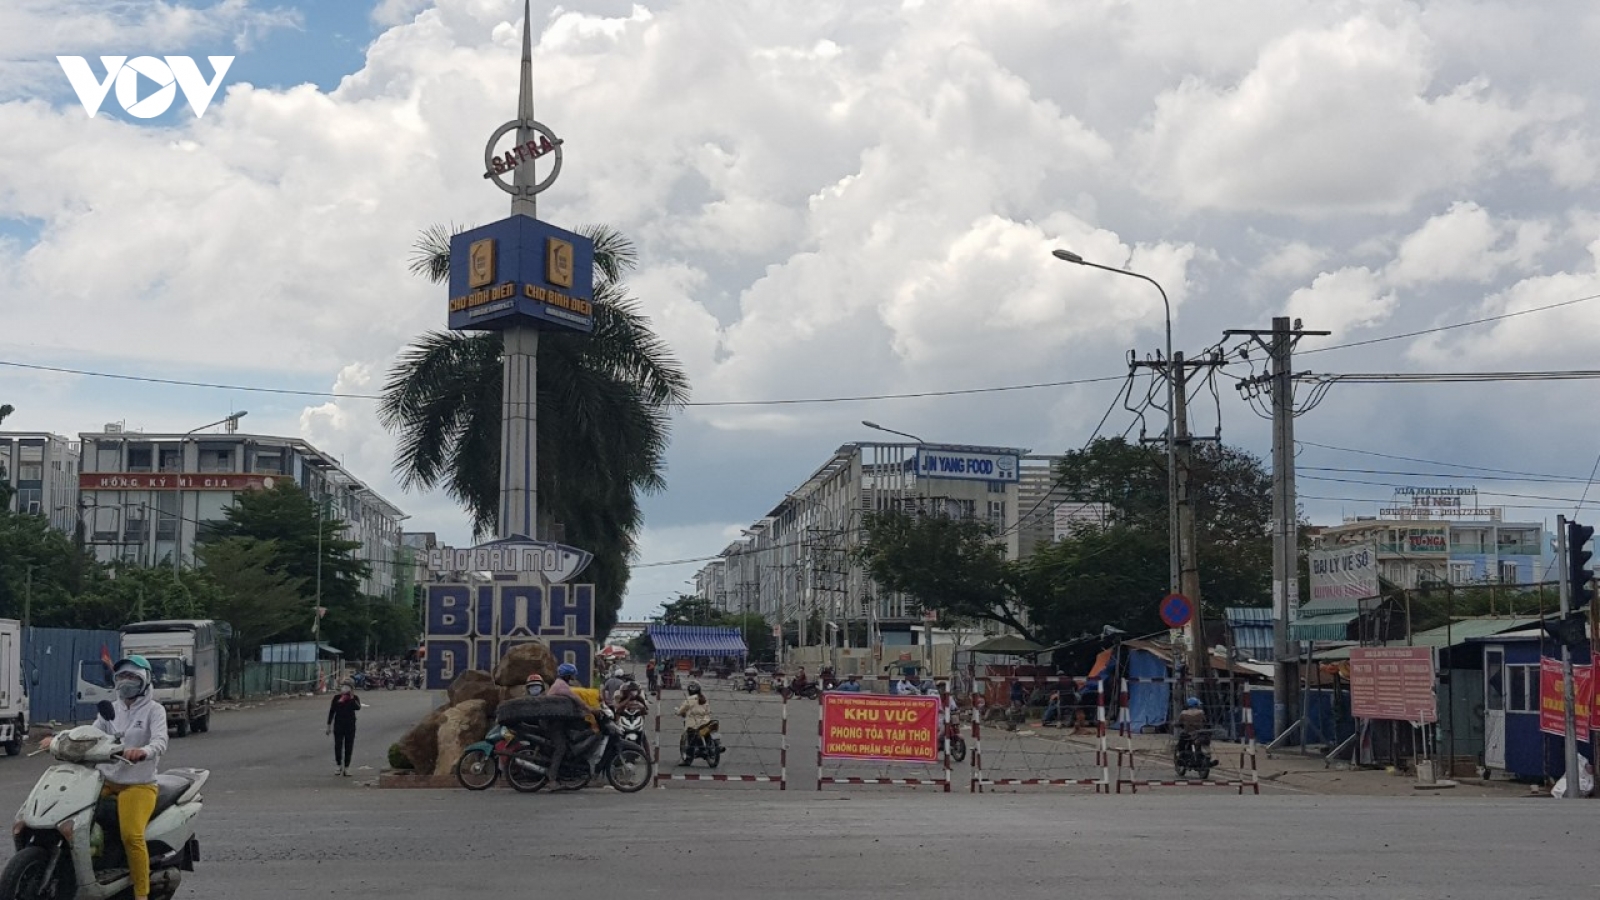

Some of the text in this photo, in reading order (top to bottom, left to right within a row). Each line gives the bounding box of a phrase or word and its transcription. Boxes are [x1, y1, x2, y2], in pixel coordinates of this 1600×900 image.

[492, 135, 554, 175] SATRA
[939, 456, 965, 473] YANG
[966, 458, 993, 475] FOOD
[204, 478, 229, 488] GIA
[844, 708, 918, 725] KHU VỰC
[830, 726, 863, 739] PHONG
[885, 729, 906, 743] TẠM
[908, 727, 931, 742] THỜI
[827, 742, 858, 753] (KHÔNG
[859, 744, 881, 756] PHẬN
